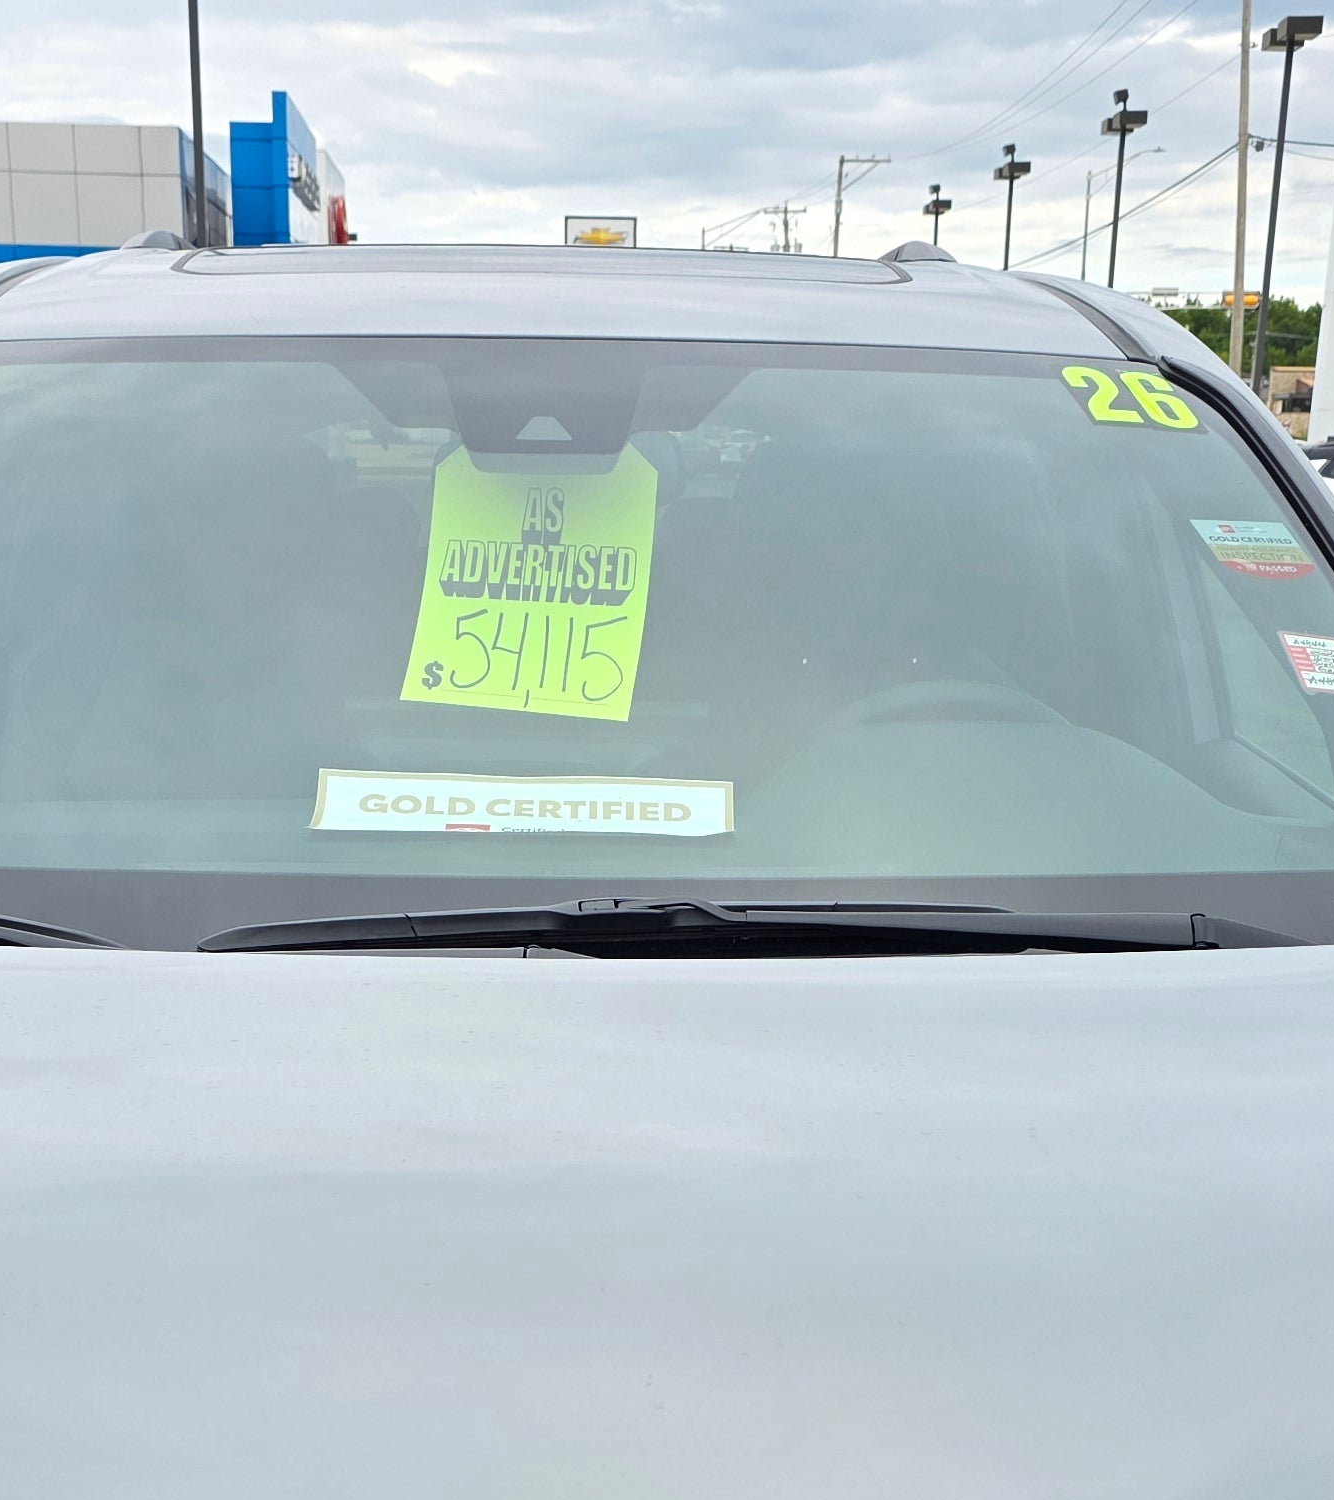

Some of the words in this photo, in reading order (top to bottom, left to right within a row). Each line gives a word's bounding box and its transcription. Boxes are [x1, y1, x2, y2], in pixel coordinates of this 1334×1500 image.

[1061, 365, 1199, 430] 26
[522, 486, 566, 540] AS
[439, 538, 638, 604] ADVERTISED
[1220, 551, 1305, 562] INSPECTION
[358, 793, 476, 816] GOLD
[485, 796, 692, 822] CERTIFIED
